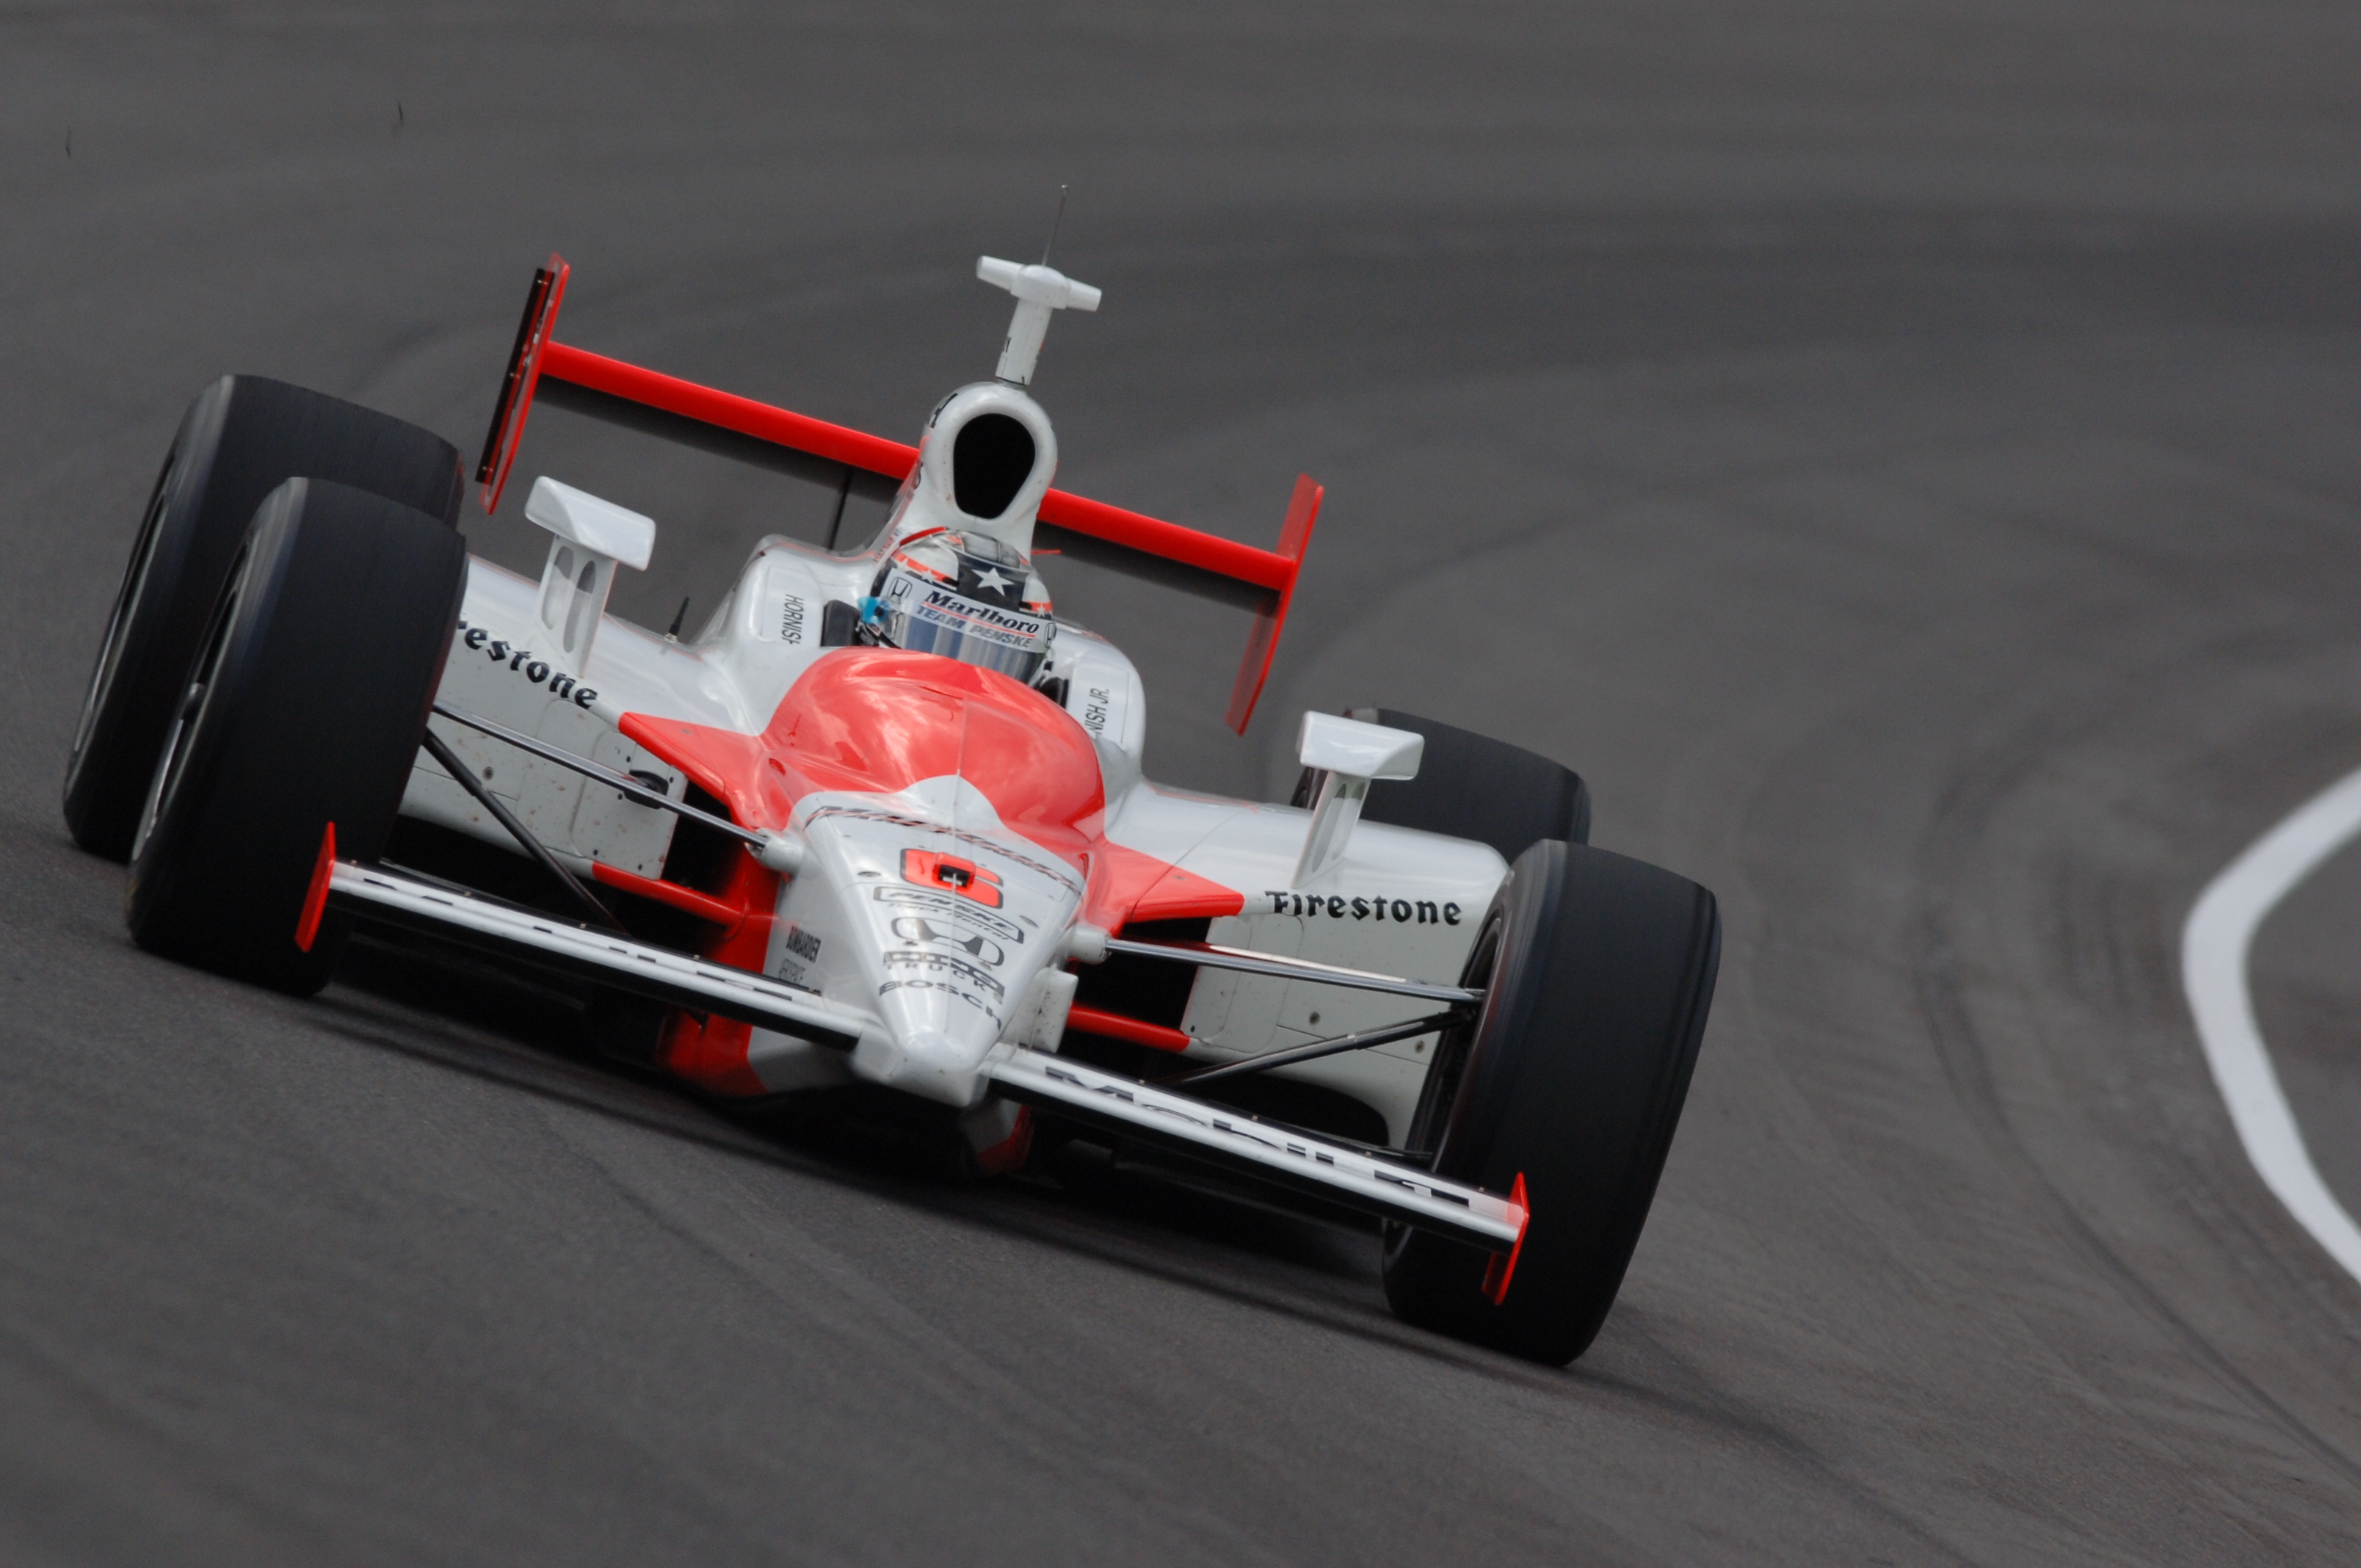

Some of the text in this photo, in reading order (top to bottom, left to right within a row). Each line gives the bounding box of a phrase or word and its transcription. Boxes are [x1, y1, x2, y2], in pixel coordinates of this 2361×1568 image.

[918, 606, 1034, 648] TEAM PENSKE
[924, 590, 1040, 634] Marlboro
[458, 620, 598, 708] estone
[1084, 688, 1109, 735] NISH JR.
[889, 893, 1015, 931] PENSKE
[1264, 890, 1462, 925] Firestone
[879, 980, 1002, 1031] BOSCH
